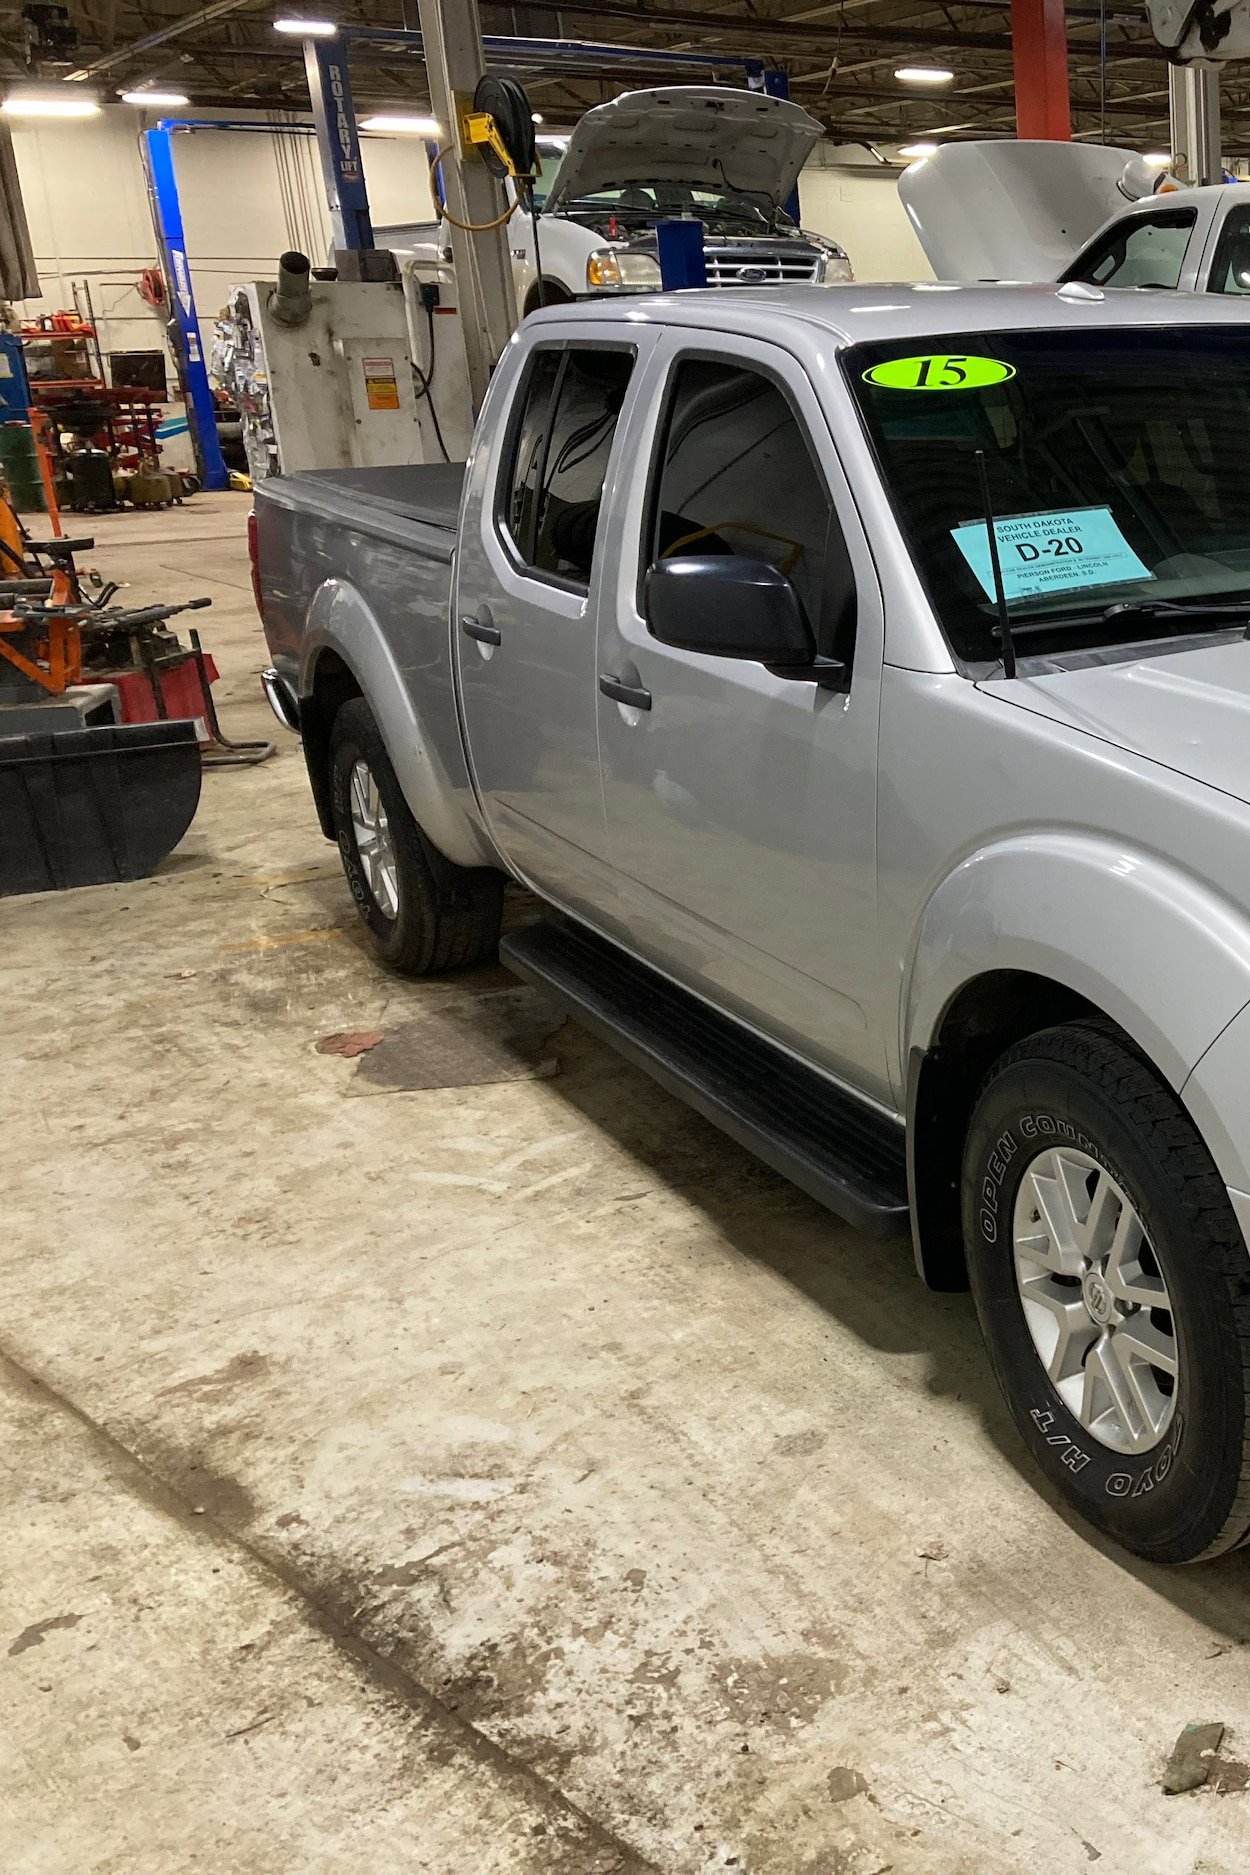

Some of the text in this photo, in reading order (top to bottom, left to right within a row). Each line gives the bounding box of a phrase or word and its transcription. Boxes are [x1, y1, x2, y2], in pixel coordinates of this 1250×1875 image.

[328, 64, 352, 160] ROTARY
[340, 160, 358, 172] LIFT
[910, 357, 968, 388] 15
[997, 518, 1074, 534] SOUTH DAKOTA
[997, 526, 1082, 543] VEHICLE DEALER
[1015, 537, 1084, 561] D-20
[1016, 561, 1109, 580] PIERSON FORD LINCOLN
[979, 1130, 1019, 1244] OPEN
[1029, 1408, 1092, 1474] H/T
[1104, 1413, 1184, 1498] TOYO
